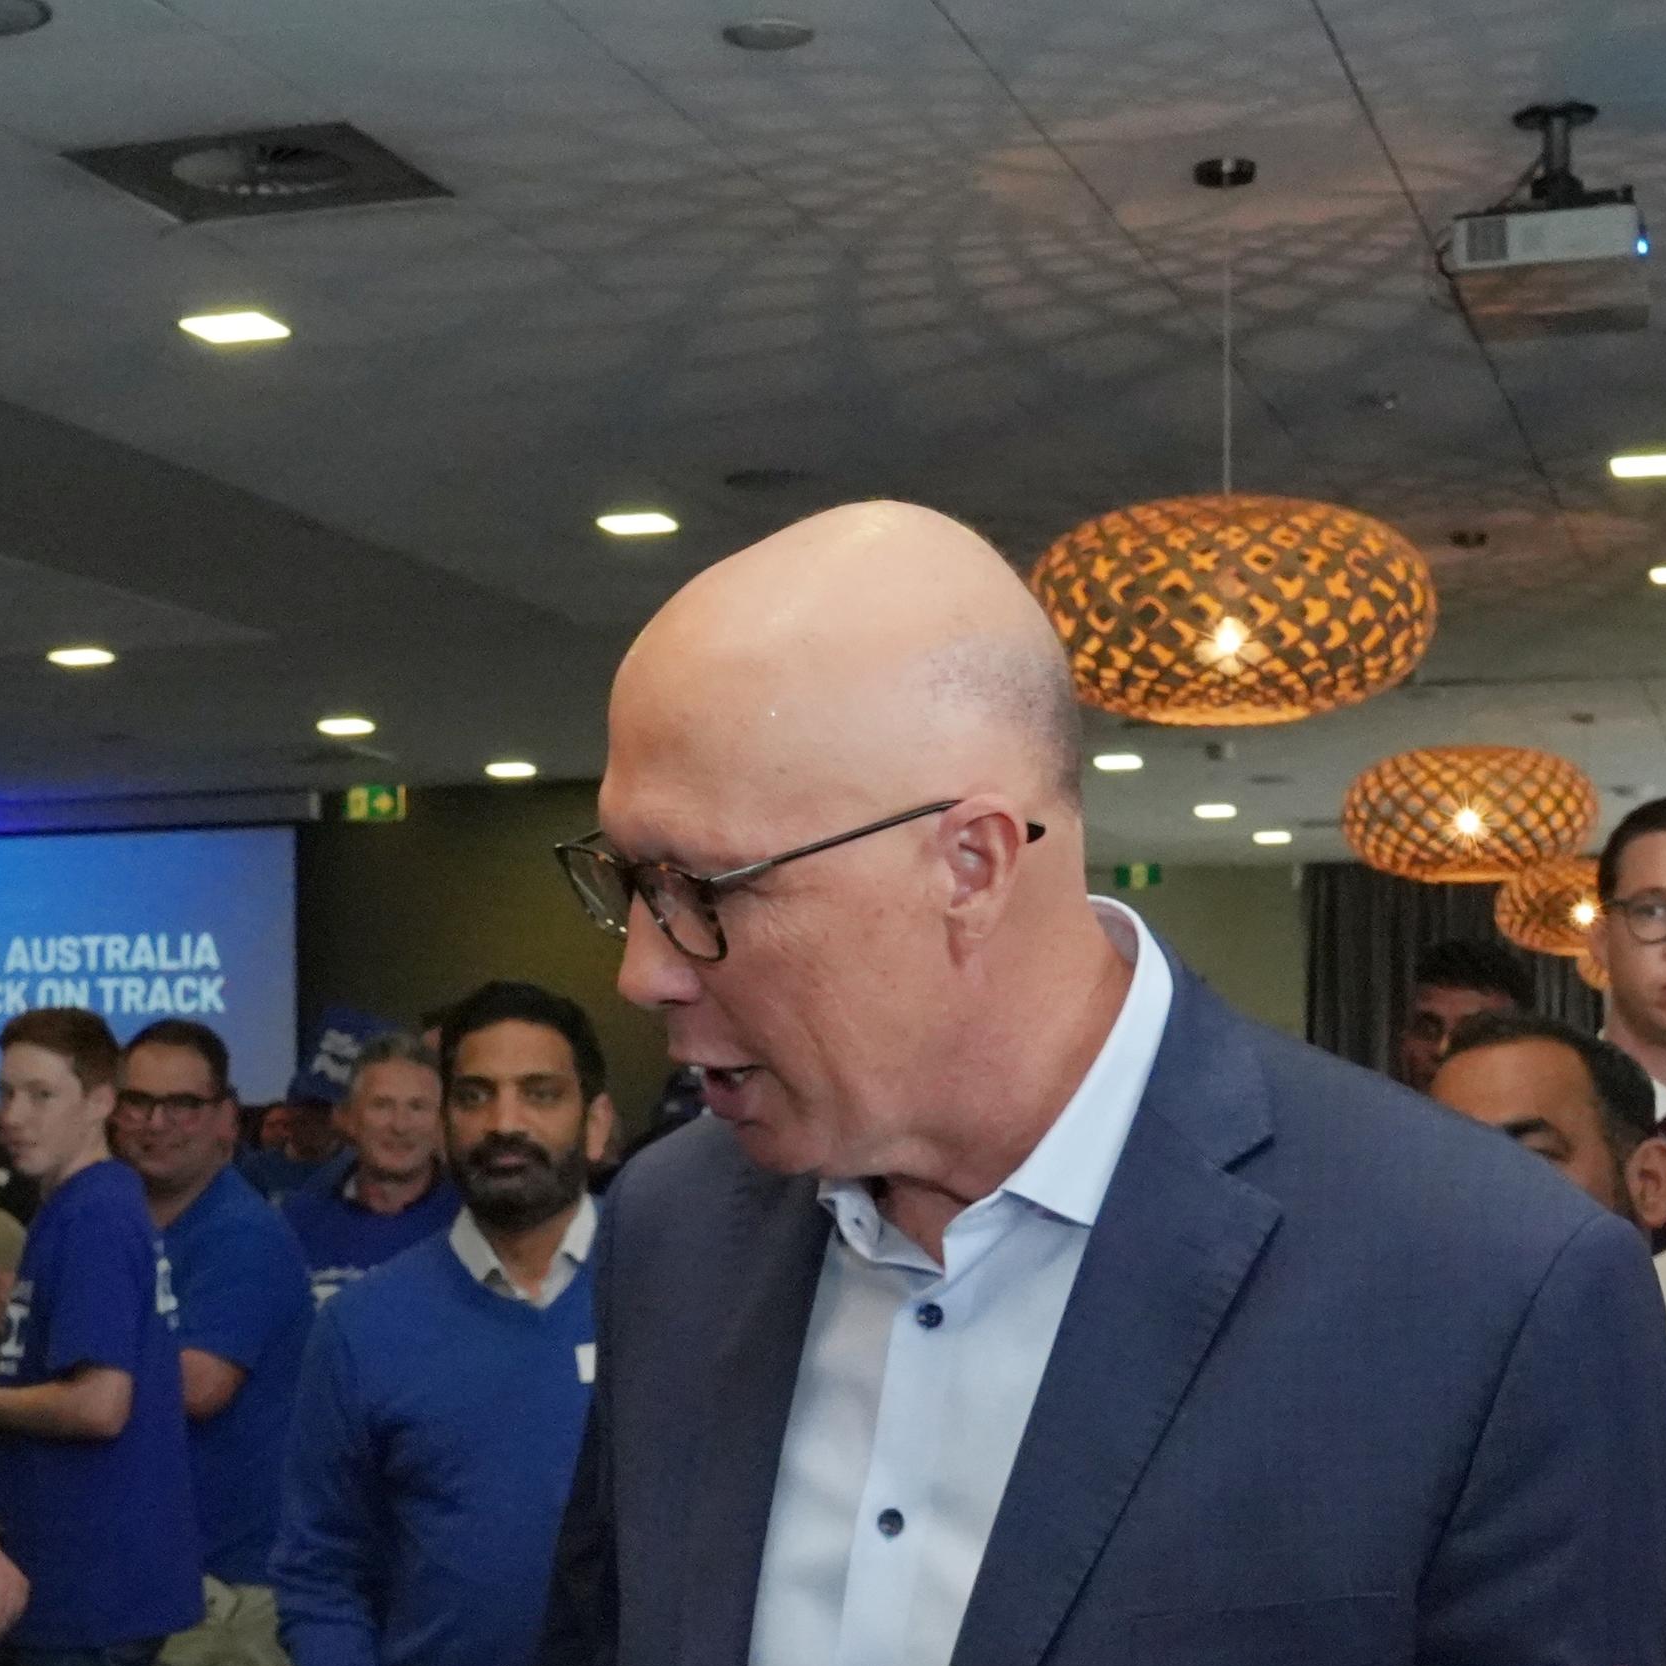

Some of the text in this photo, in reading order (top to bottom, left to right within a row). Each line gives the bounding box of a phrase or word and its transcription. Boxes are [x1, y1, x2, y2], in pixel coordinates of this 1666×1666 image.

[3, 932, 221, 973] AUSTRALIA
[36, 977, 89, 1010] ON
[96, 974, 226, 1014] TRACK
